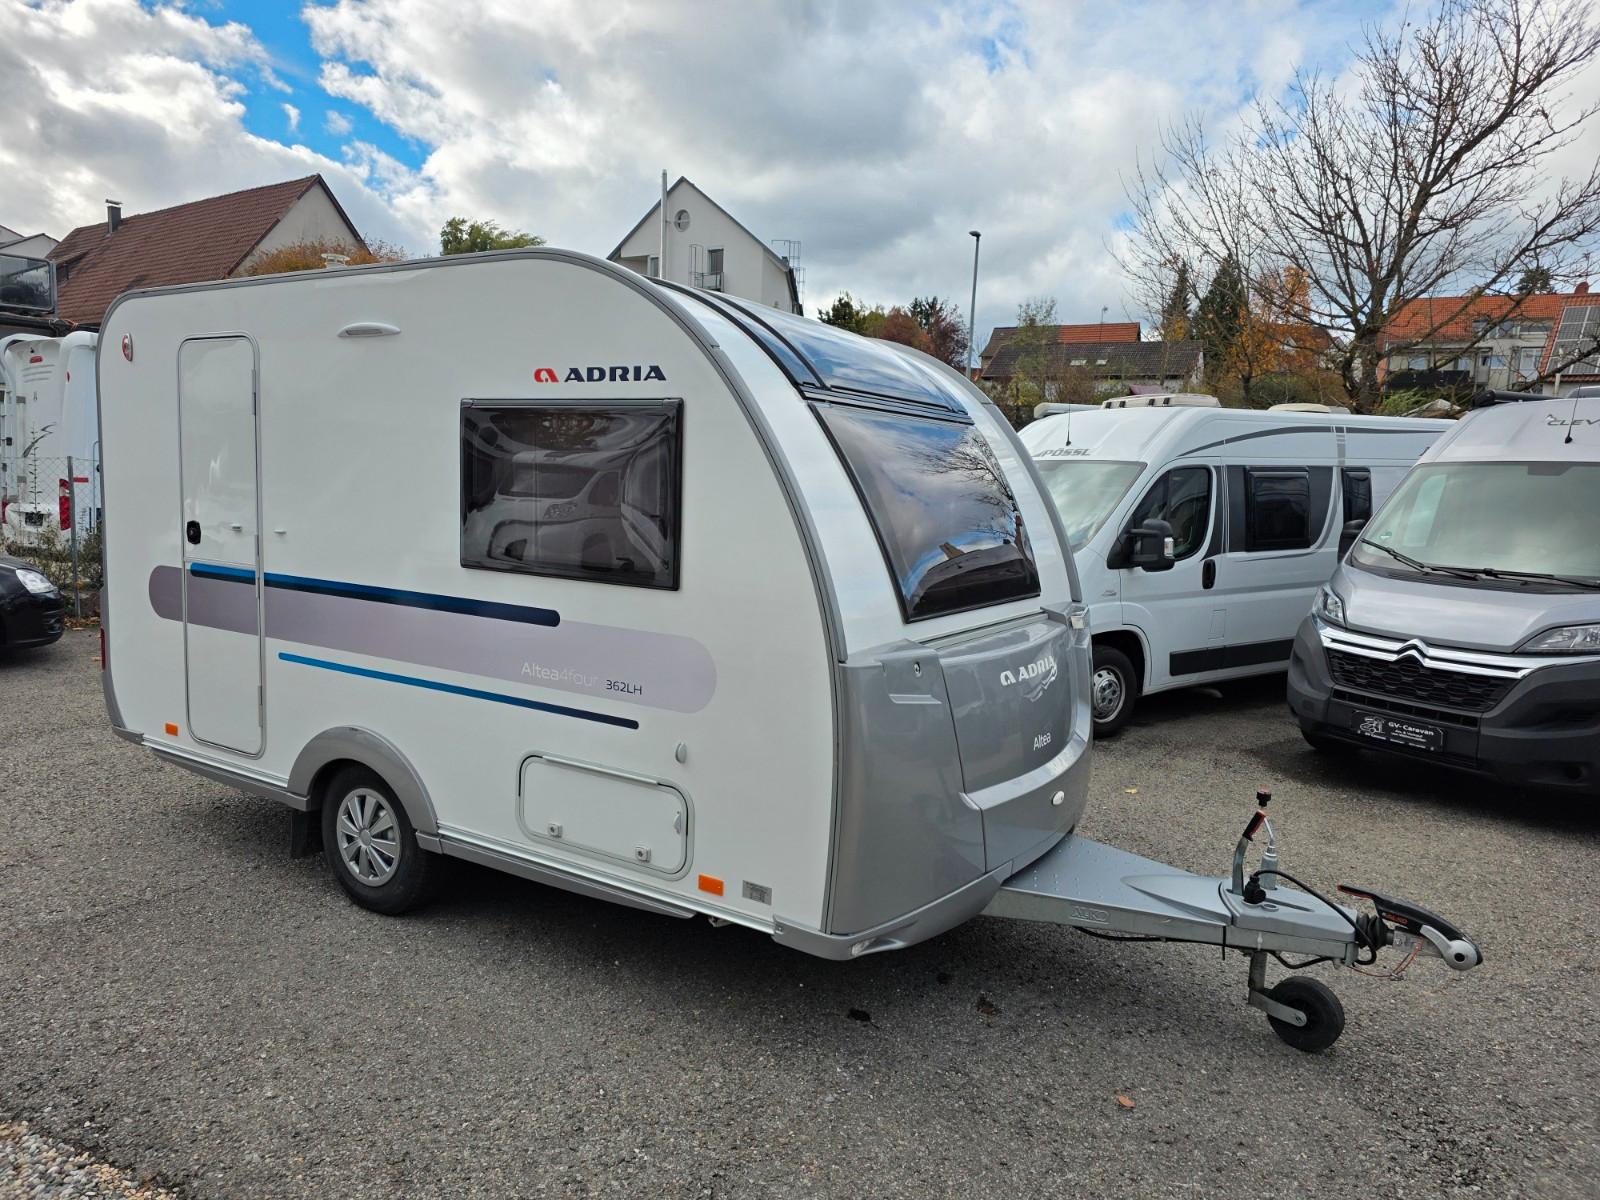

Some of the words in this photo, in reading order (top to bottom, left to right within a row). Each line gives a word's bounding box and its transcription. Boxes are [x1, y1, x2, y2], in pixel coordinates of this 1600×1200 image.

[564, 365, 667, 383] ADRIA
[1018, 655, 1057, 682] ADRIA
[605, 679, 643, 695] 362LH
[1033, 732, 1052, 751] Altea
